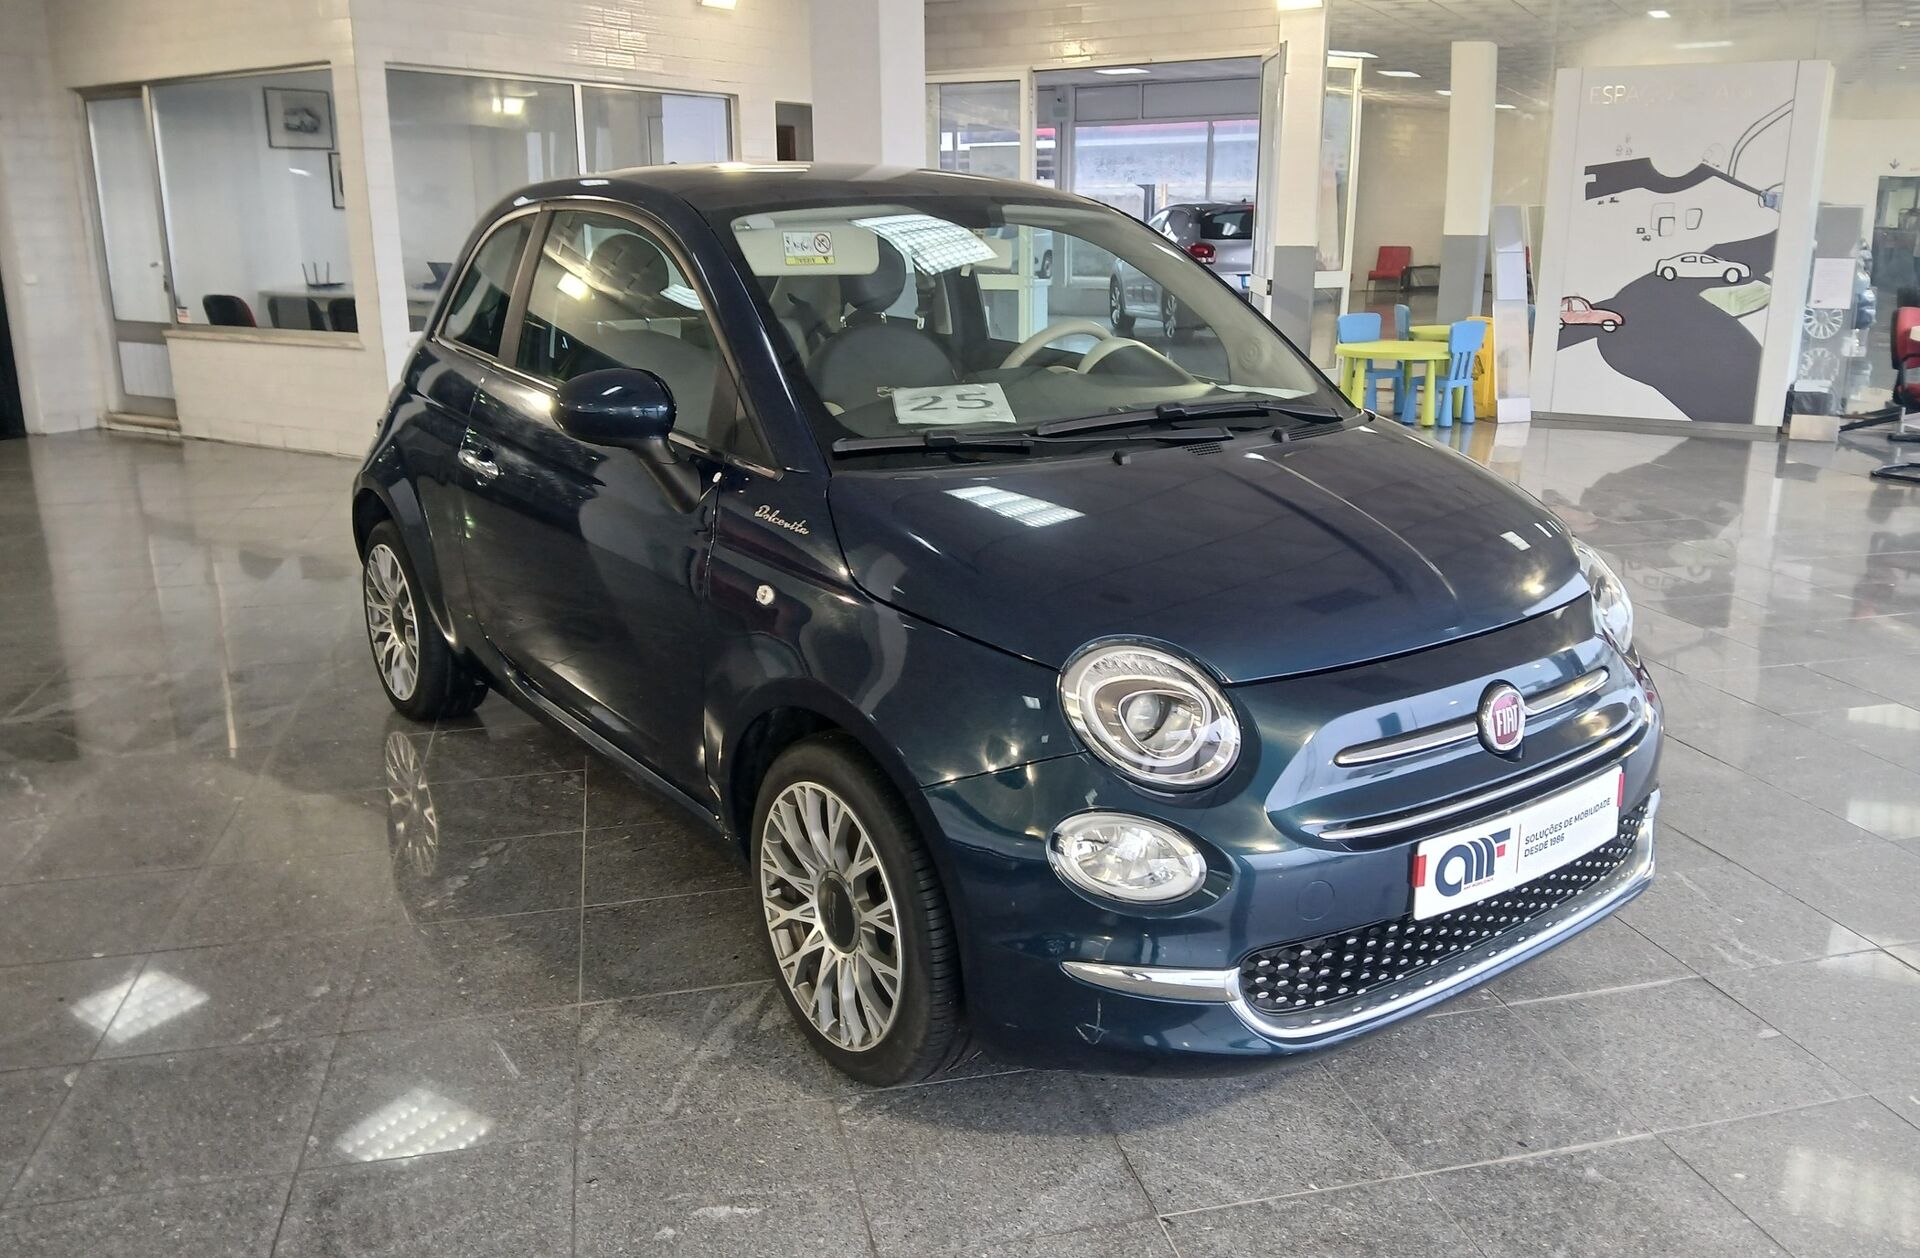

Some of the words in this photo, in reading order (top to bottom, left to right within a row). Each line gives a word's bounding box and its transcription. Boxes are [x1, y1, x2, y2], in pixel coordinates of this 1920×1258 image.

[908, 393, 994, 411] 25
[1495, 704, 1518, 737] FIAT
[1525, 822, 1563, 845] SOLUÇÕES
[1564, 817, 1573, 828] DE
[1574, 797, 1611, 823] MOBILIDADE
[1524, 840, 1549, 858] DESDE
